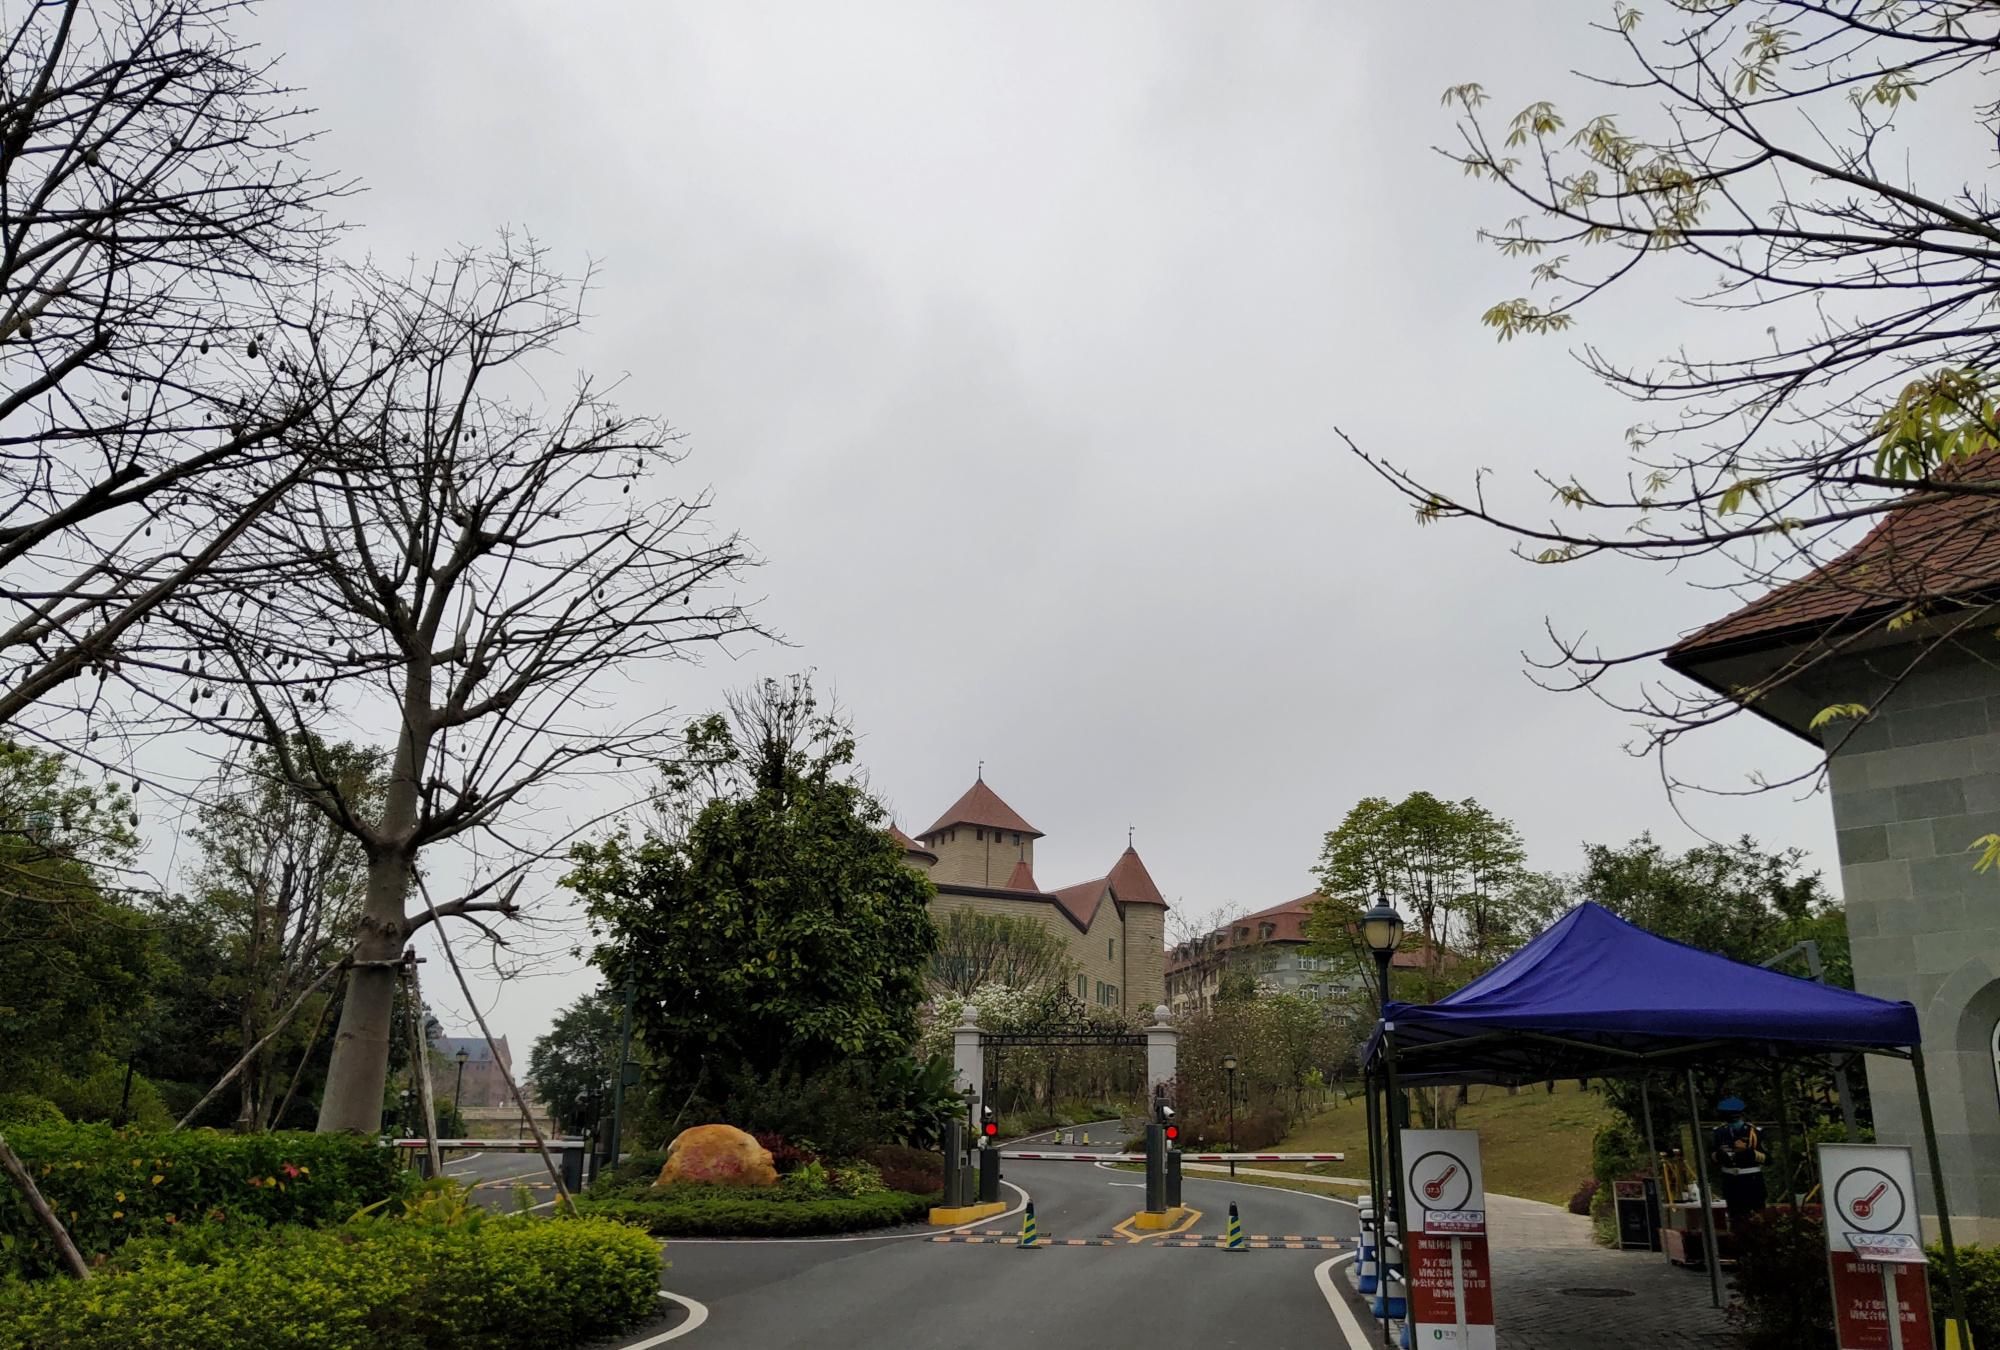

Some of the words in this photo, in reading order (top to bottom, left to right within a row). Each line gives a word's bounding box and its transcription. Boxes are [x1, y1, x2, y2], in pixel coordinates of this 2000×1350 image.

[1422, 1258, 1472, 1268] 为了您的康
